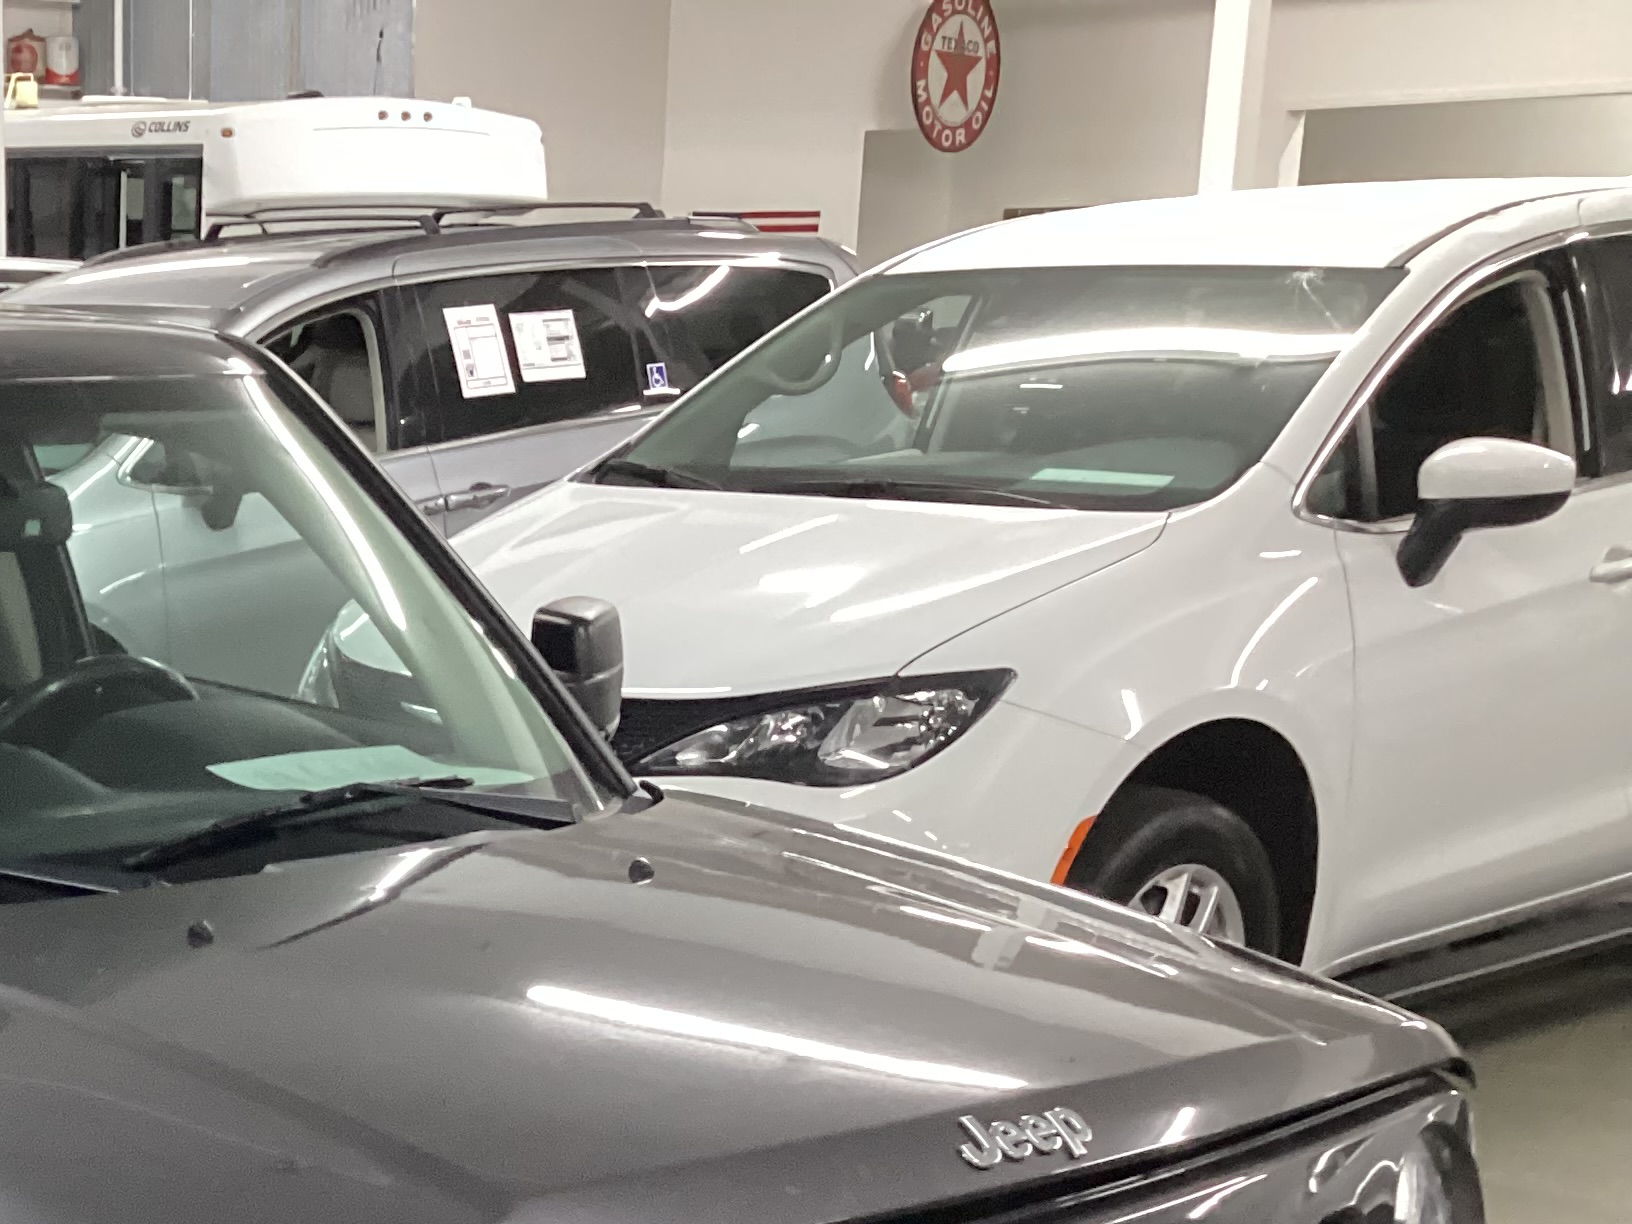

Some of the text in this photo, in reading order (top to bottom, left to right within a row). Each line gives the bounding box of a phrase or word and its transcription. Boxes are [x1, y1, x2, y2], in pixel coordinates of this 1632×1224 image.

[920, 0, 997, 58] GASOLINE
[147, 120, 191, 133] COLLINS
[916, 79, 994, 147] MOTOR OIL
[958, 1106, 1093, 1167] Jeep
